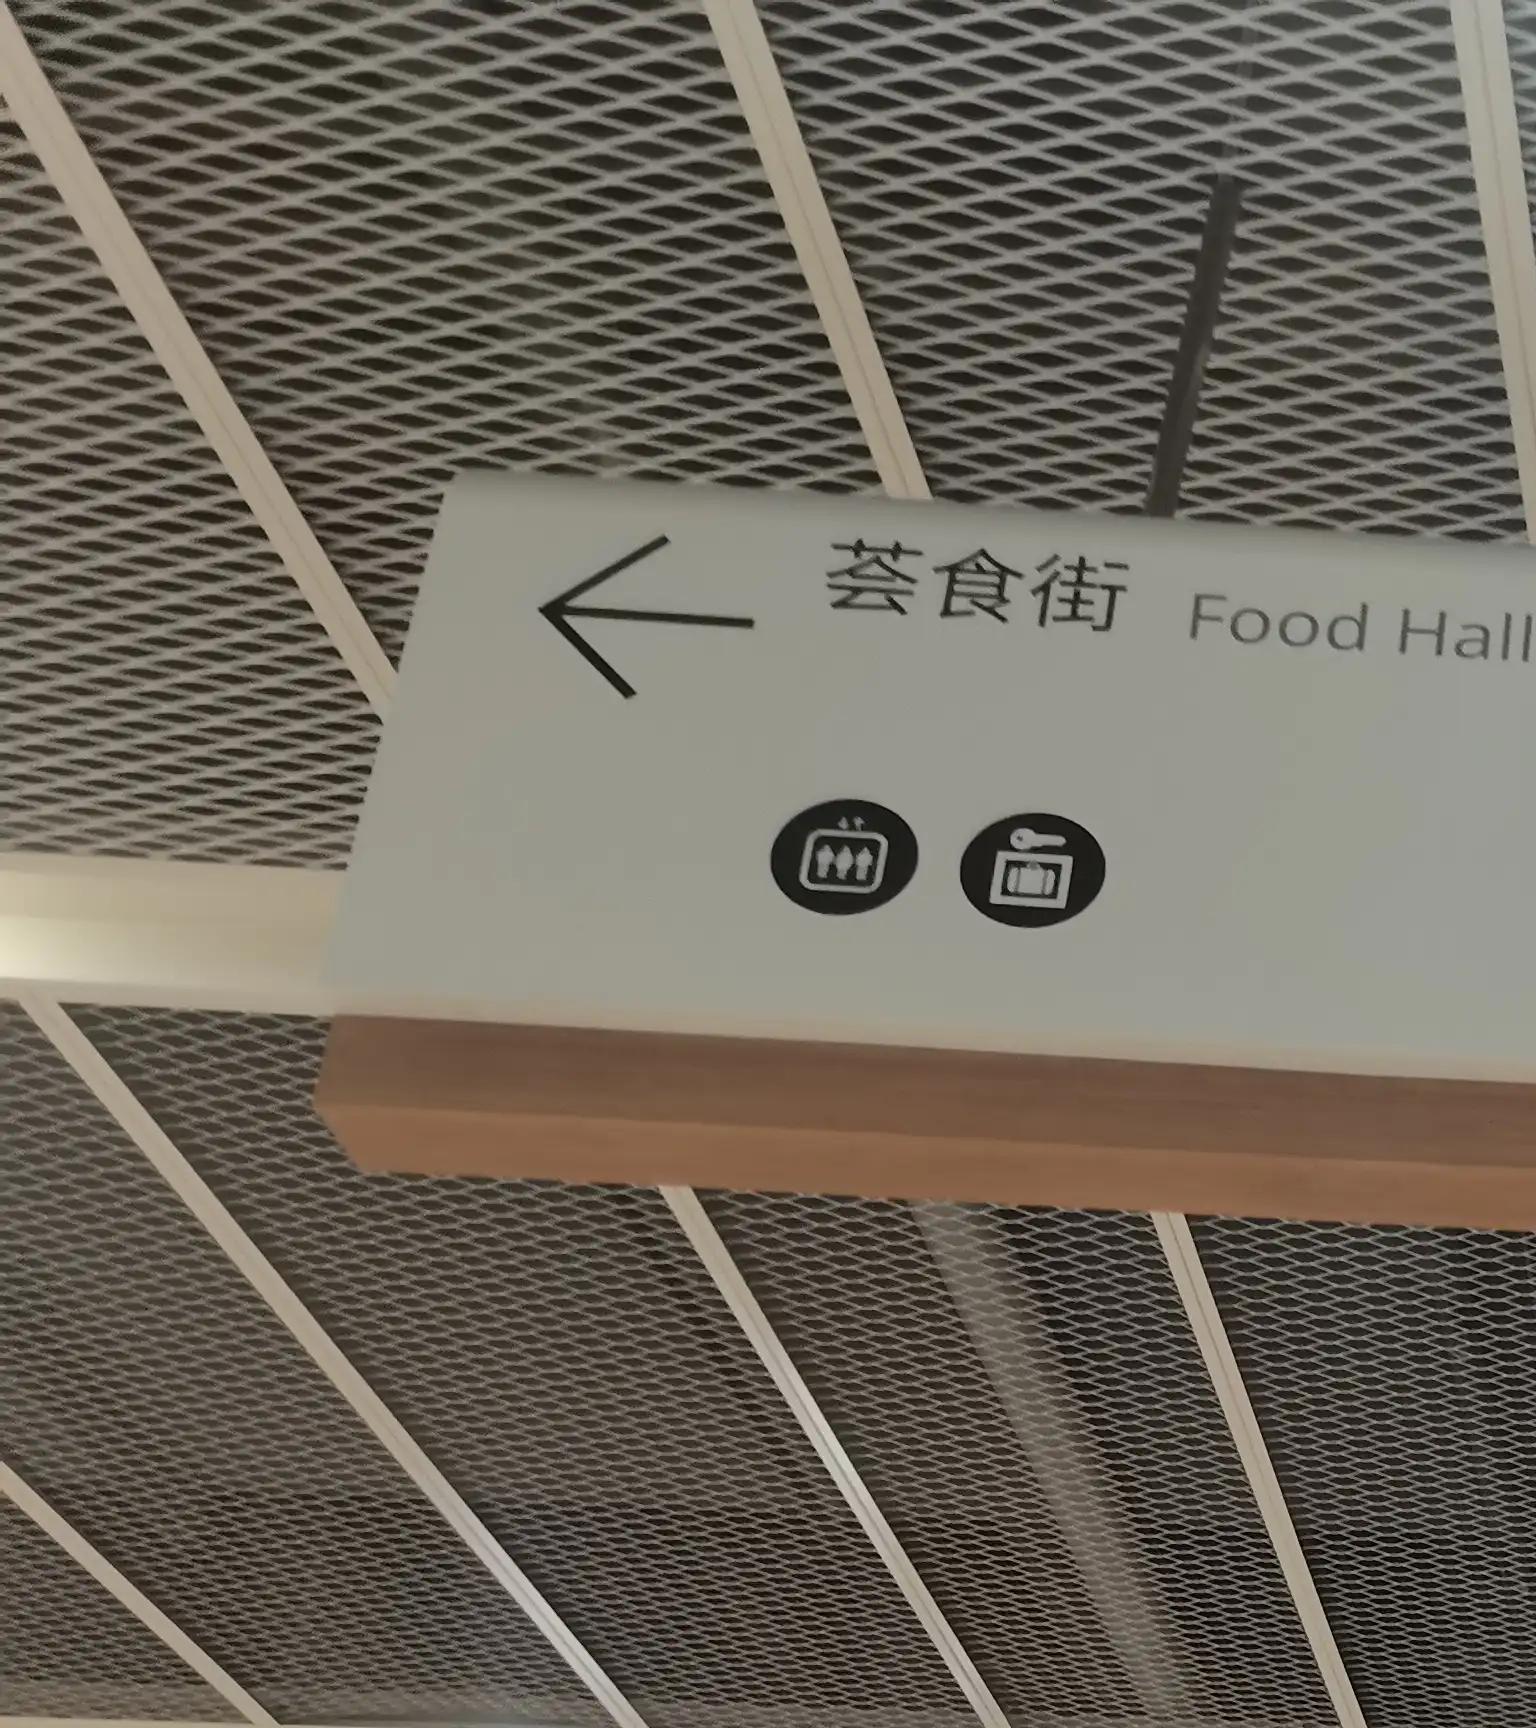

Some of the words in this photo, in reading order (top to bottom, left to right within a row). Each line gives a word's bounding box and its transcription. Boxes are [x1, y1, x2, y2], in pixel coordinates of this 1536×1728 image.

[826, 538, 1130, 632] 荟食街
[1190, 593, 1368, 652] Food
[1399, 608, 1532, 663] Hall
